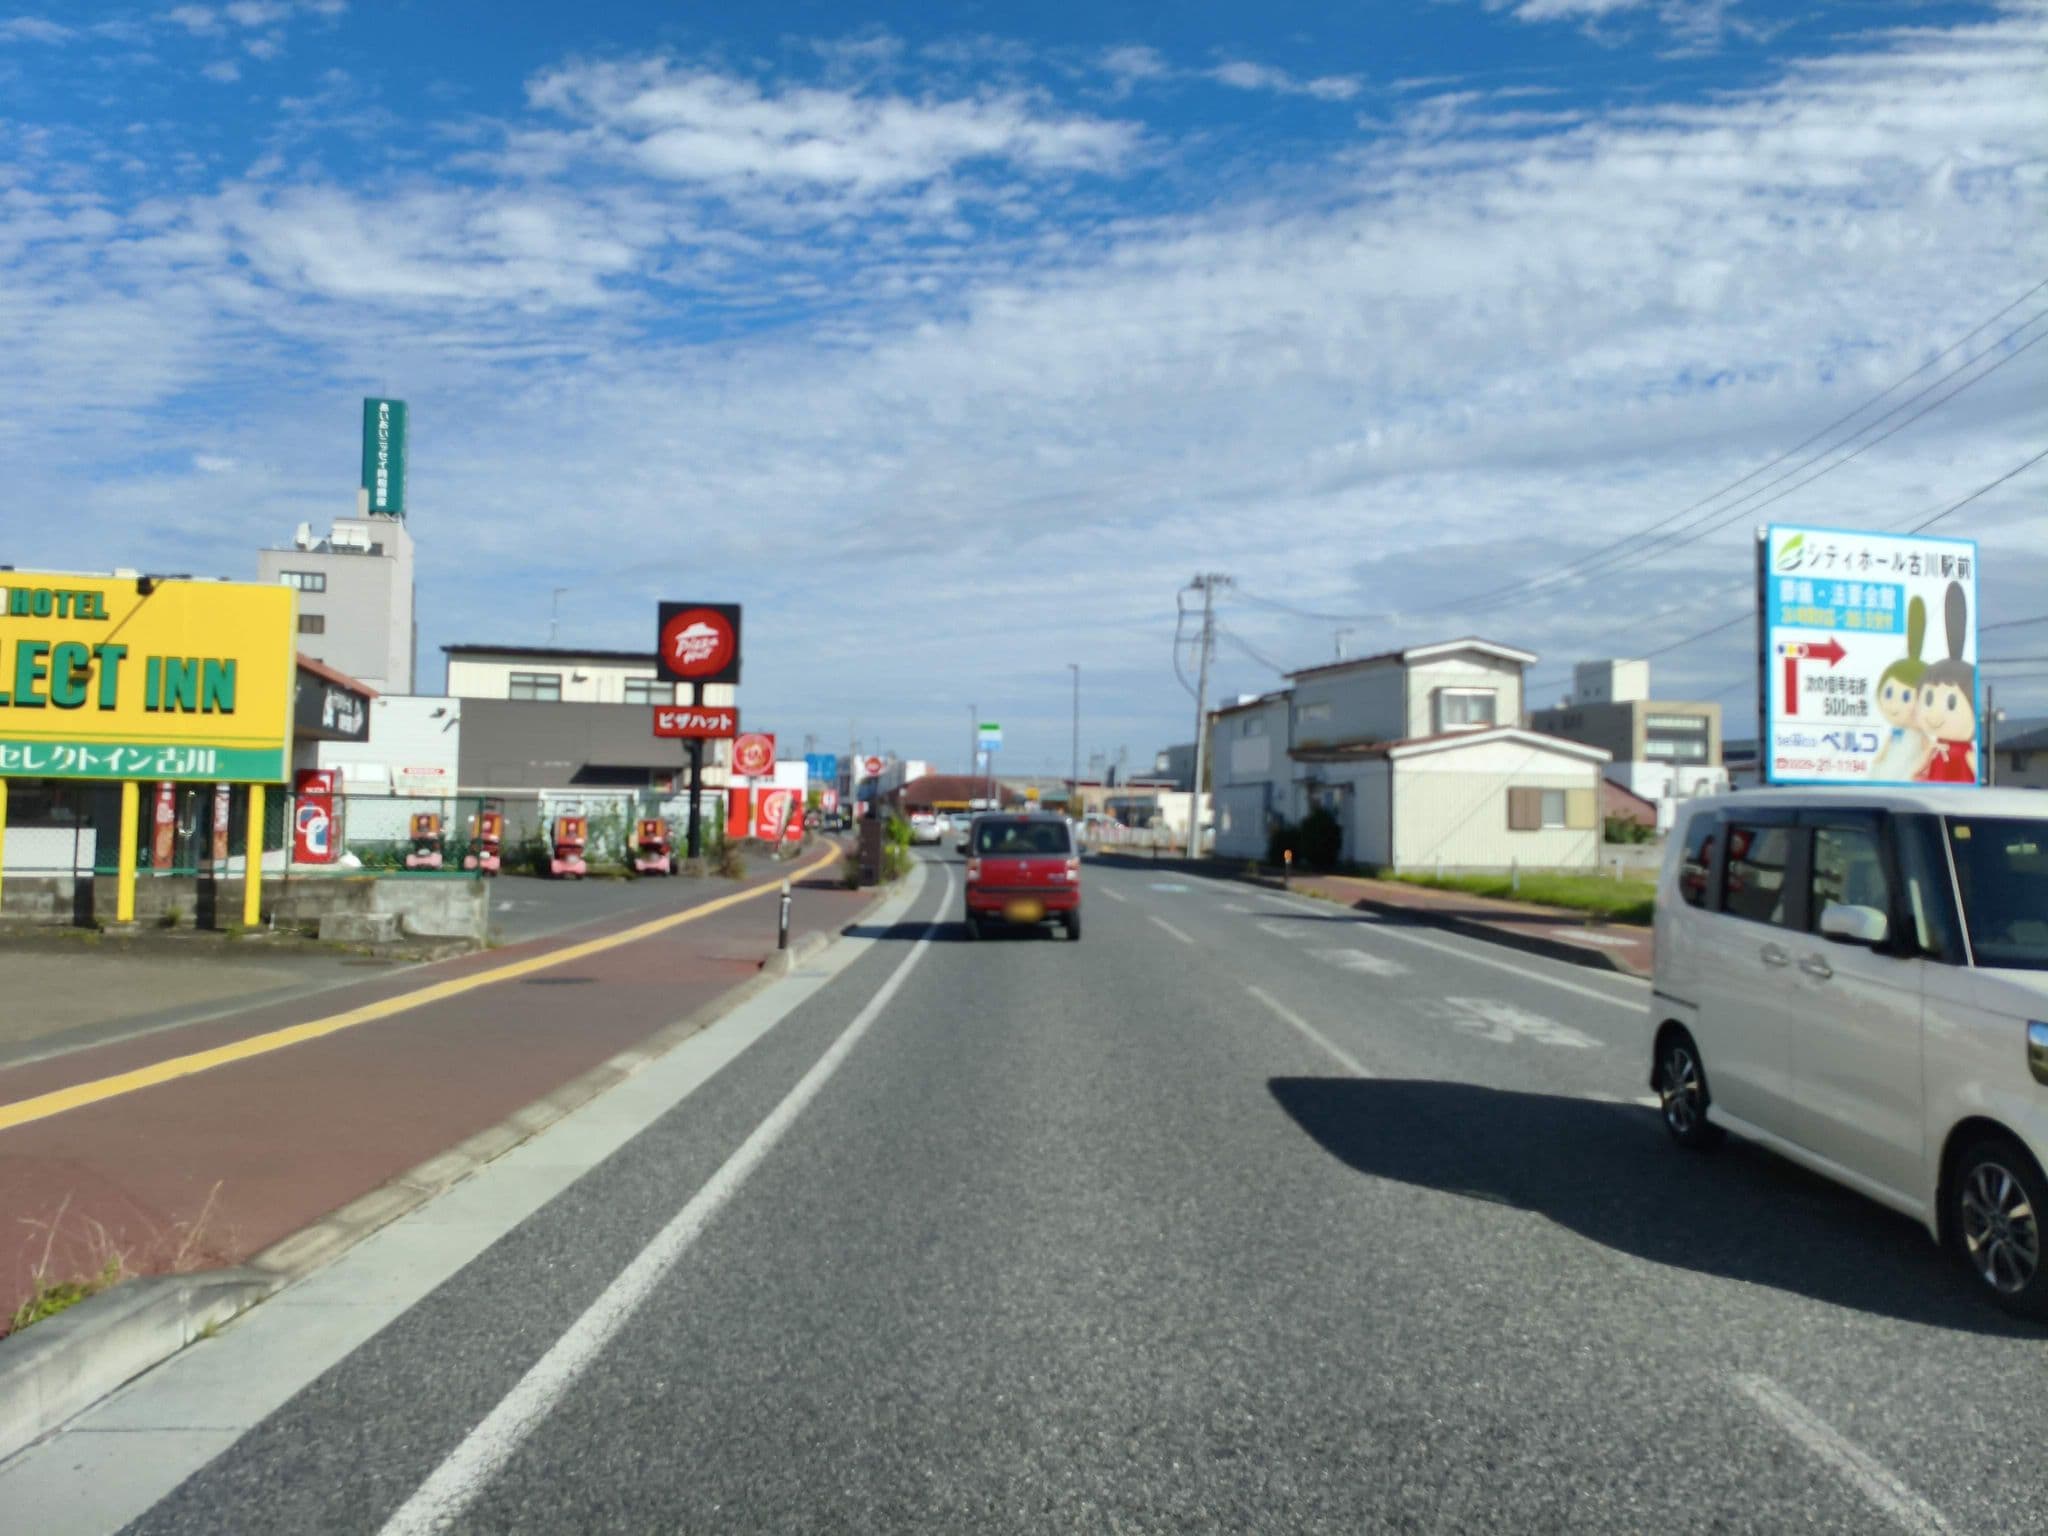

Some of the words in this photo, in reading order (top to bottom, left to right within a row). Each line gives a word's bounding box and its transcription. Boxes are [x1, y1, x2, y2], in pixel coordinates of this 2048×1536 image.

[1806, 541, 1971, 580] シティホール古川駅前
[9, 587, 110, 620] HOTEL
[144, 655, 237, 715] INN
[1821, 730, 1879, 753] ベルコ
[0, 745, 217, 775] セレクトイン古川
